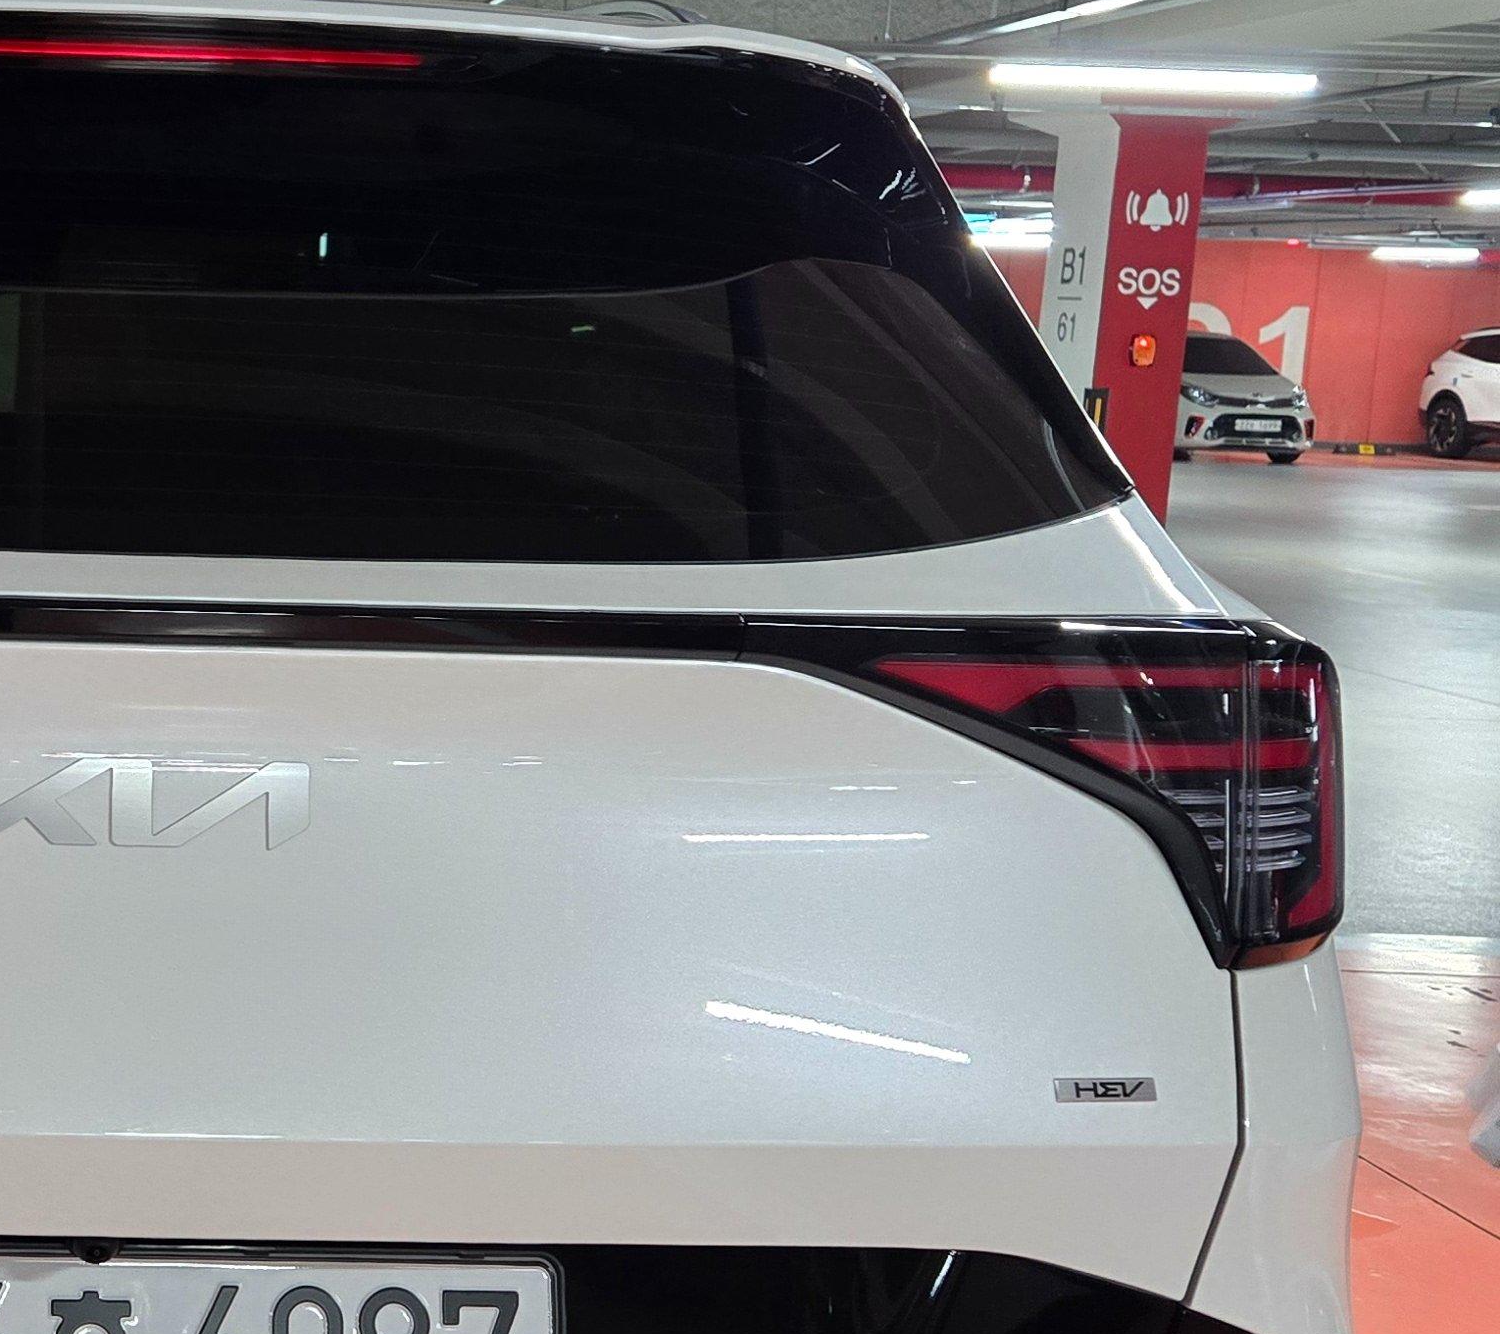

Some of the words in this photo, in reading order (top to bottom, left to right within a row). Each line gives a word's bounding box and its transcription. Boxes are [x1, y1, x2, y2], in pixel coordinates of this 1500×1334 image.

[1061, 245, 1087, 285] B1
[1117, 266, 1181, 297] SOS
[1057, 312, 1076, 343] 61
[1074, 1081, 1144, 1099] HEV
